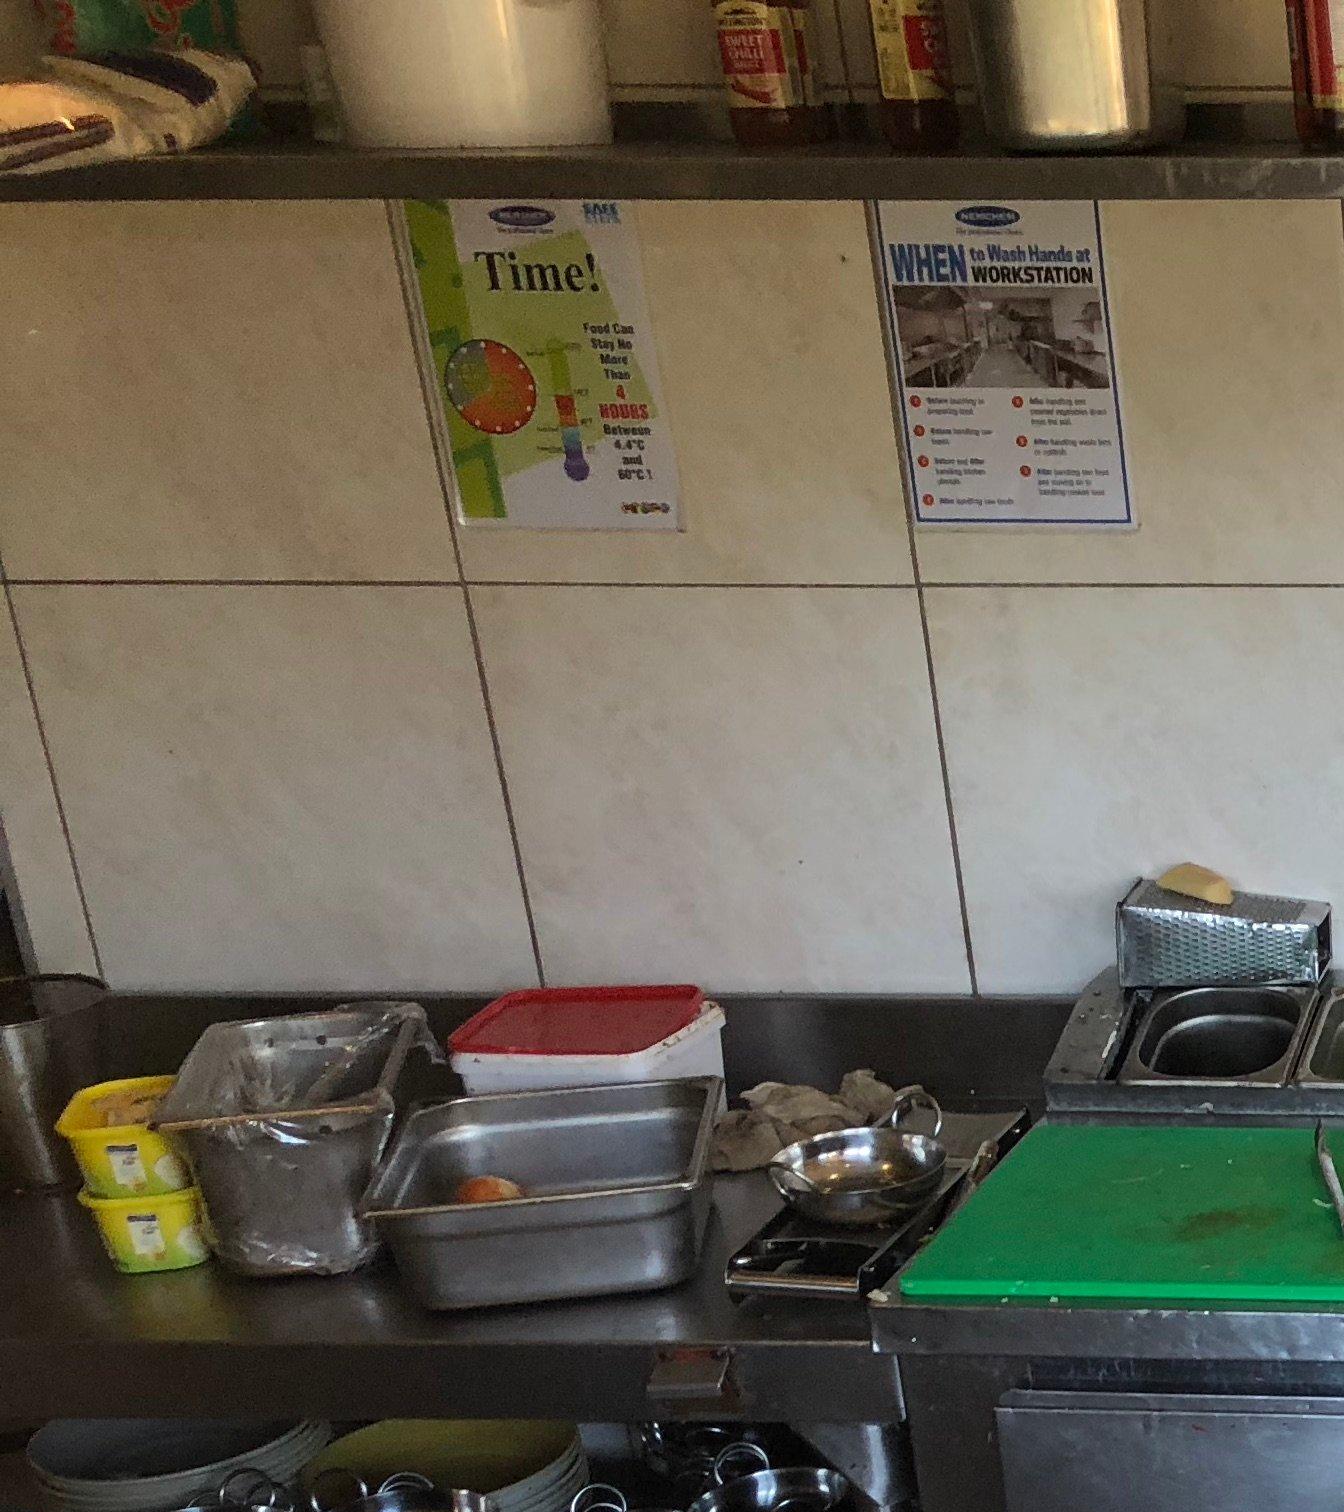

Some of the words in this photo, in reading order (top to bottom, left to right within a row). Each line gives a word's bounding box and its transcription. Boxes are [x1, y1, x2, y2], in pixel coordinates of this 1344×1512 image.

[725, 34, 763, 47] SWEET
[889, 243, 968, 283] WHEN
[970, 247, 986, 262] to
[987, 244, 1026, 263] Wash
[1027, 245, 1074, 263] Hands
[1075, 247, 1091, 264] at
[473, 251, 601, 292] Time!
[971, 266, 1094, 284] WORKSTATION
[611, 323, 634, 335] Can
[599, 353, 628, 365] More
[604, 368, 631, 381] Than
[599, 403, 649, 421] HOURS
[603, 424, 651, 437] Between
[622, 454, 643, 466] and
